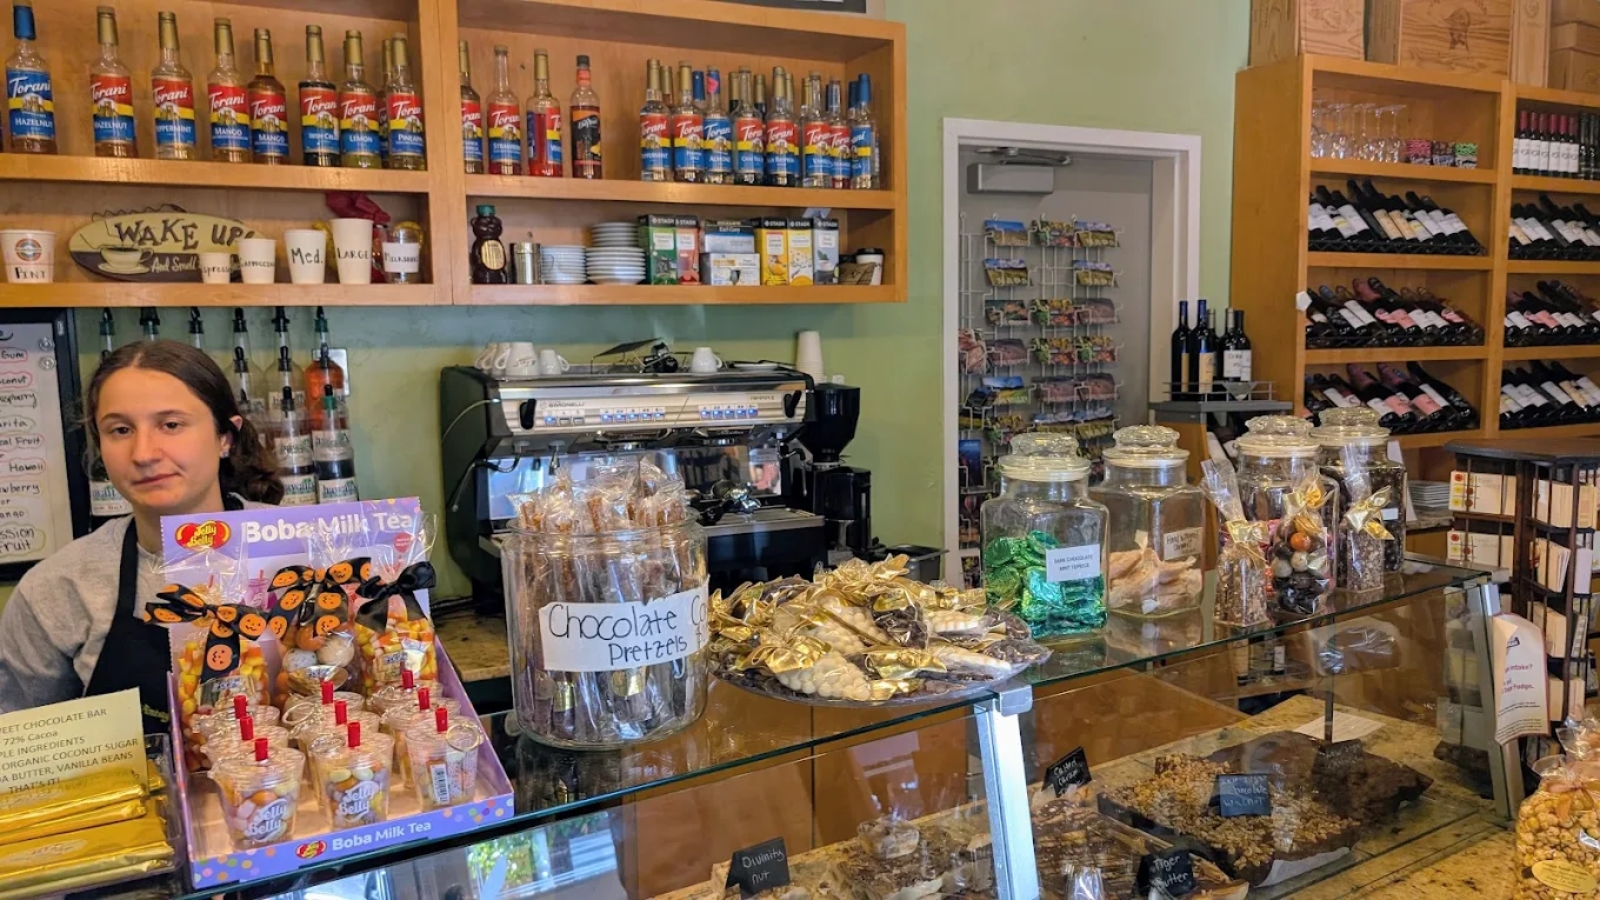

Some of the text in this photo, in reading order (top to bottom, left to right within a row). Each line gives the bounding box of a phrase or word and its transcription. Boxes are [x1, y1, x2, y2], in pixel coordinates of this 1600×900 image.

[9, 76, 51, 99] Torani
[91, 82, 127, 100] Torani
[153, 86, 188, 104] Torani
[209, 92, 245, 113] Torani
[251, 100, 286, 120] Torani
[304, 95, 337, 116] Toran
[341, 100, 376, 119] Torani
[15, 118, 53, 128] HAZELNUT
[492, 110, 520, 128] Toran
[155, 125, 192, 133] PPERMINT
[215, 127, 242, 136] MANGO
[640, 121, 667, 137] Torani
[677, 120, 703, 138] Toran
[705, 122, 731, 140] Toran
[741, 125, 762, 142] Tora
[767, 127, 793, 144] Torani
[258, 134, 285, 143] MANGO
[349, 135, 373, 143] LEMON
[114, 218, 199, 250] WAKE
[291, 249, 323, 264] Med.
[337, 250, 369, 260] LARGE
[14, 266, 46, 279] PINT
[151, 256, 197, 273] And Smell
[15, 436, 40, 446] Fruit
[9, 462, 43, 472] Hawaii
[194, 520, 217, 537] Jelly
[244, 511, 412, 543] Boba Milk Tea
[187, 534, 214, 547] Belly
[549, 604, 678, 641] Chocolate
[608, 634, 688, 666] Pretzels
[23, 712, 85, 731] CHOCOLATE
[87, 708, 108, 719] BAR
[3, 731, 59, 746] 72% Cacoa
[17, 736, 86, 755] INGREDIENTS
[2, 738, 139, 771] ORGANIC COCONUT SUGAR
[12, 766, 55, 781] BUTTER,
[56, 758, 99, 773] VANILLA
[101, 751, 134, 763] BEANS
[8, 780, 46, 794] THAT'S
[341, 780, 379, 803] Jelly
[253, 799, 287, 822] Jelly
[336, 799, 370, 820] Belly
[244, 818, 282, 840] Belly
[332, 833, 373, 851] Boba
[374, 826, 405, 842] Milk
[408, 821, 432, 834] Tea
[741, 848, 785, 868] Divinity
[1152, 855, 1181, 872] Tiger
